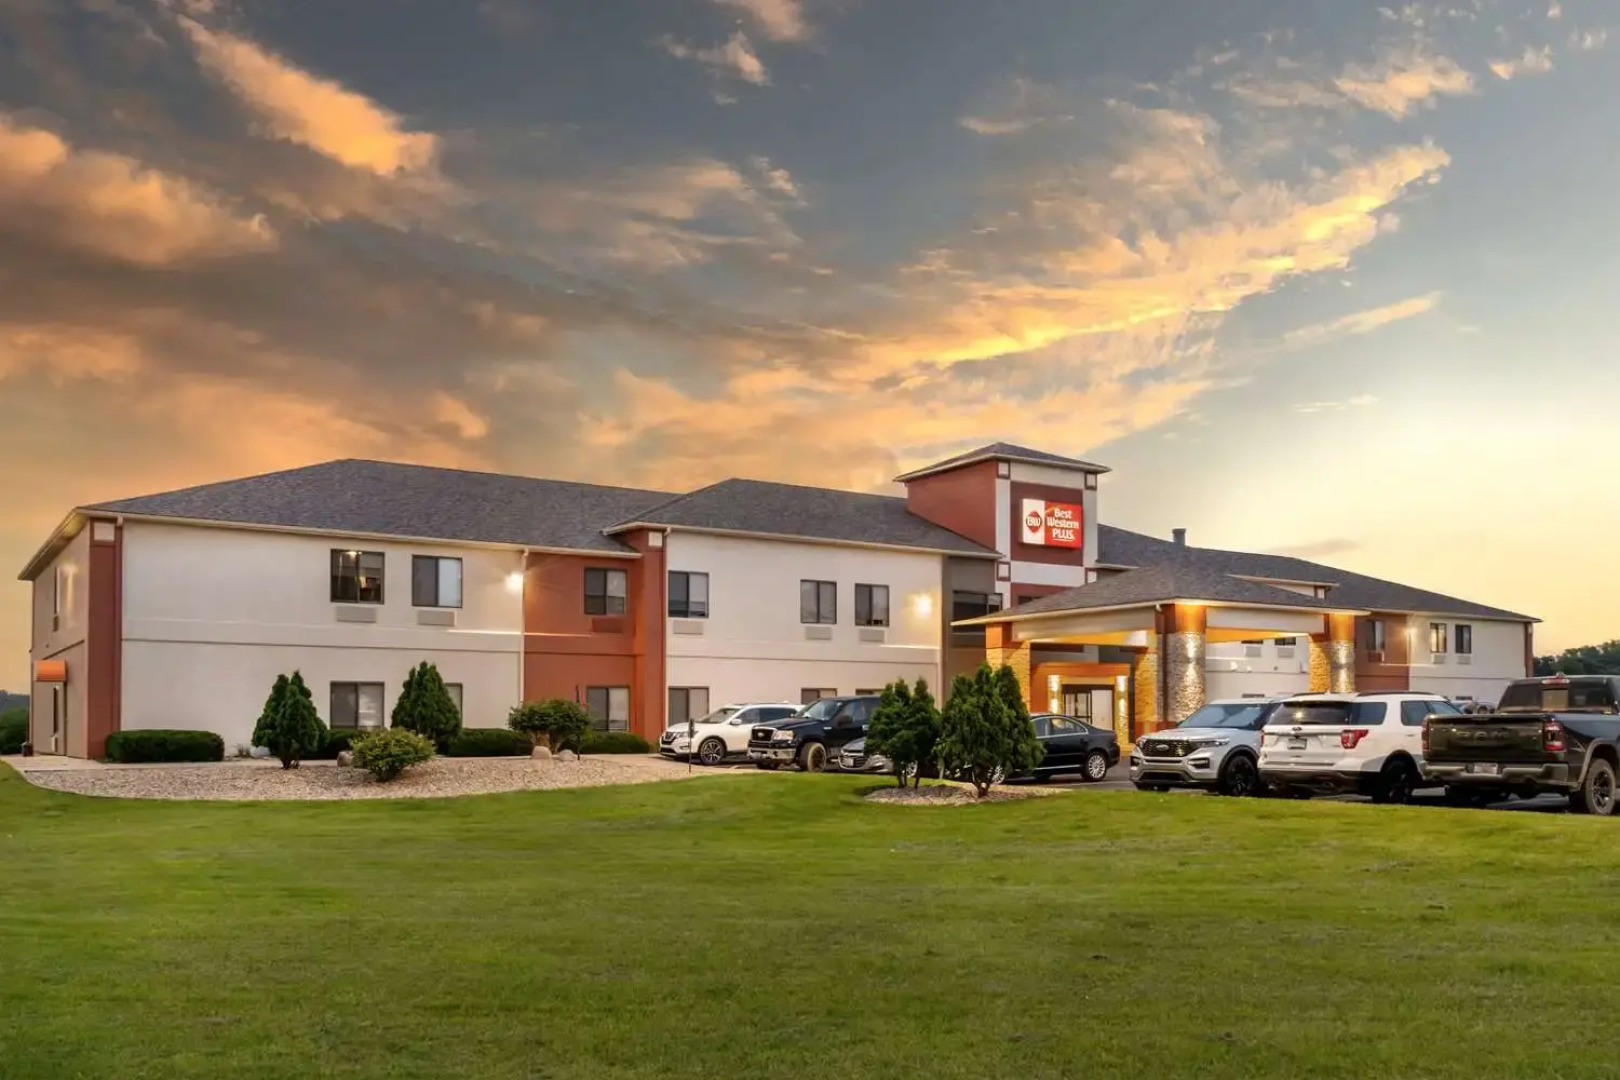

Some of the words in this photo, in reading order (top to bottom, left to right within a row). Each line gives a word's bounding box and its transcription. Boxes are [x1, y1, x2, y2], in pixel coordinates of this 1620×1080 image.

[1054, 507, 1072, 519] Best
[1046, 516, 1080, 529] Western
[1052, 529, 1075, 540] PLUS
